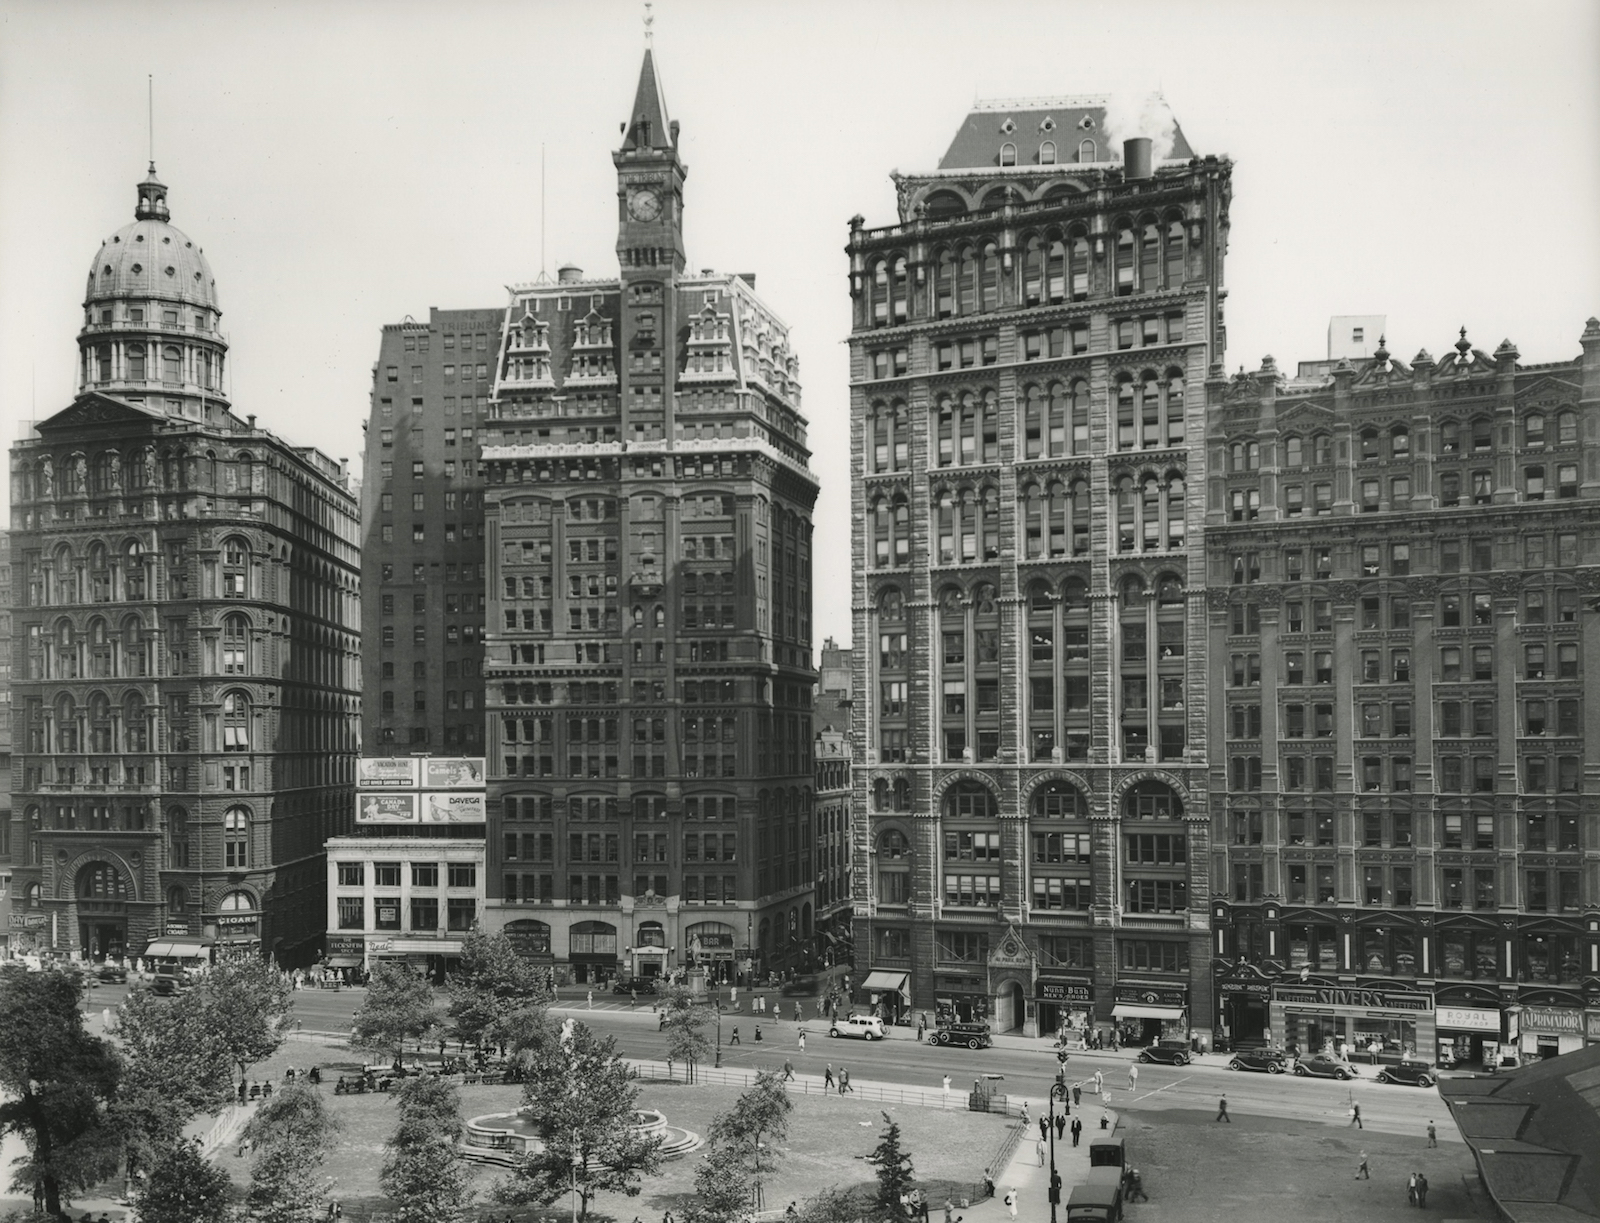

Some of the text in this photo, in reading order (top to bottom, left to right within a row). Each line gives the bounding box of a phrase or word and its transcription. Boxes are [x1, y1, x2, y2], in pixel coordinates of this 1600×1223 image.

[428, 765, 457, 775] Camels
[218, 915, 257, 925] CIGARS
[703, 937, 720, 946] BAR
[1067, 986, 1089, 995] Bush
[1319, 989, 1384, 1007] SILVER'S
[1384, 1001, 1425, 1011] CAFETERIA
[1447, 1011, 1488, 1021] ROYAL
